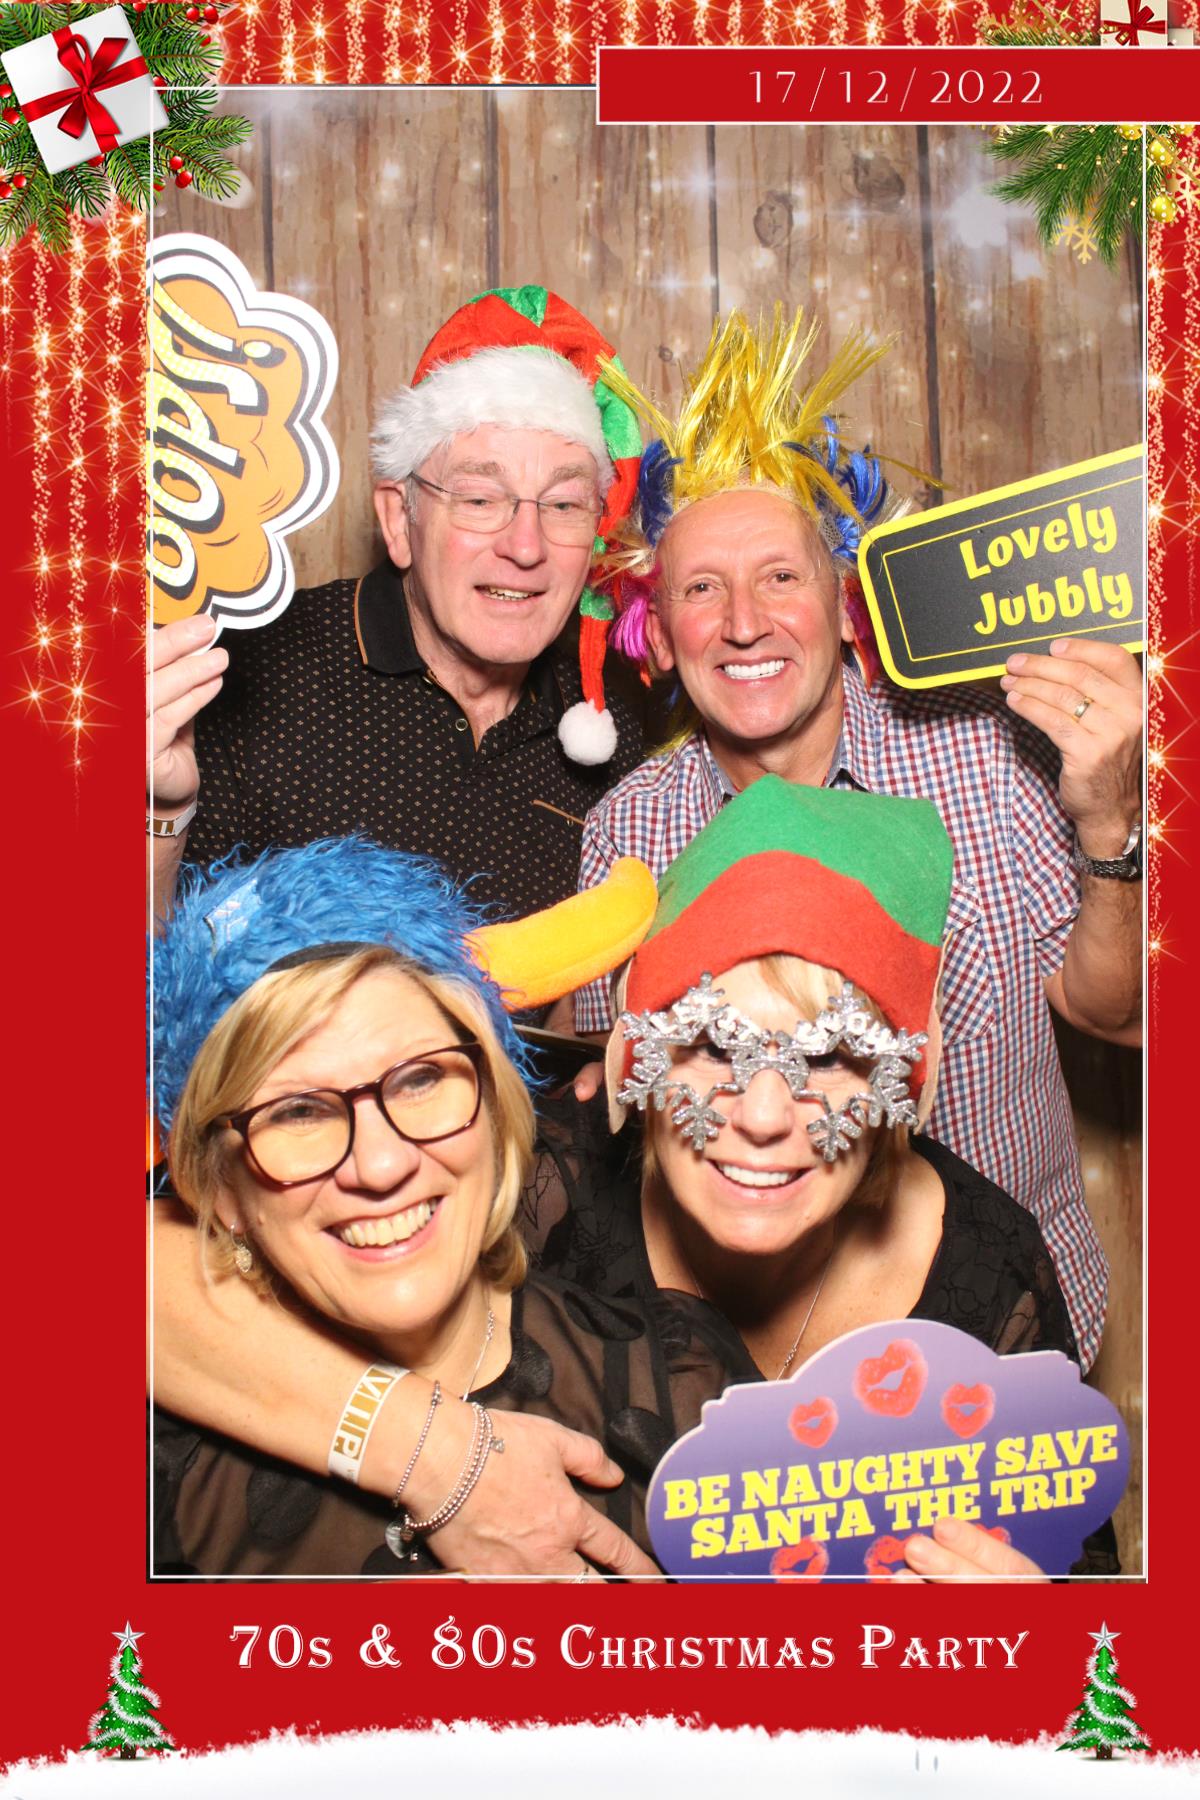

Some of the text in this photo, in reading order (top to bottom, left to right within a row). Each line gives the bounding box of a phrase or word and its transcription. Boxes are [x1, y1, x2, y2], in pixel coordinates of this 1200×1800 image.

[959, 502, 1118, 580] Lovely
[973, 567, 1134, 635] Jubbly
[663, 1424, 1119, 1520] BE NAUGHTY SAVE
[690, 1466, 1097, 1559] SANTA THE TRIP
